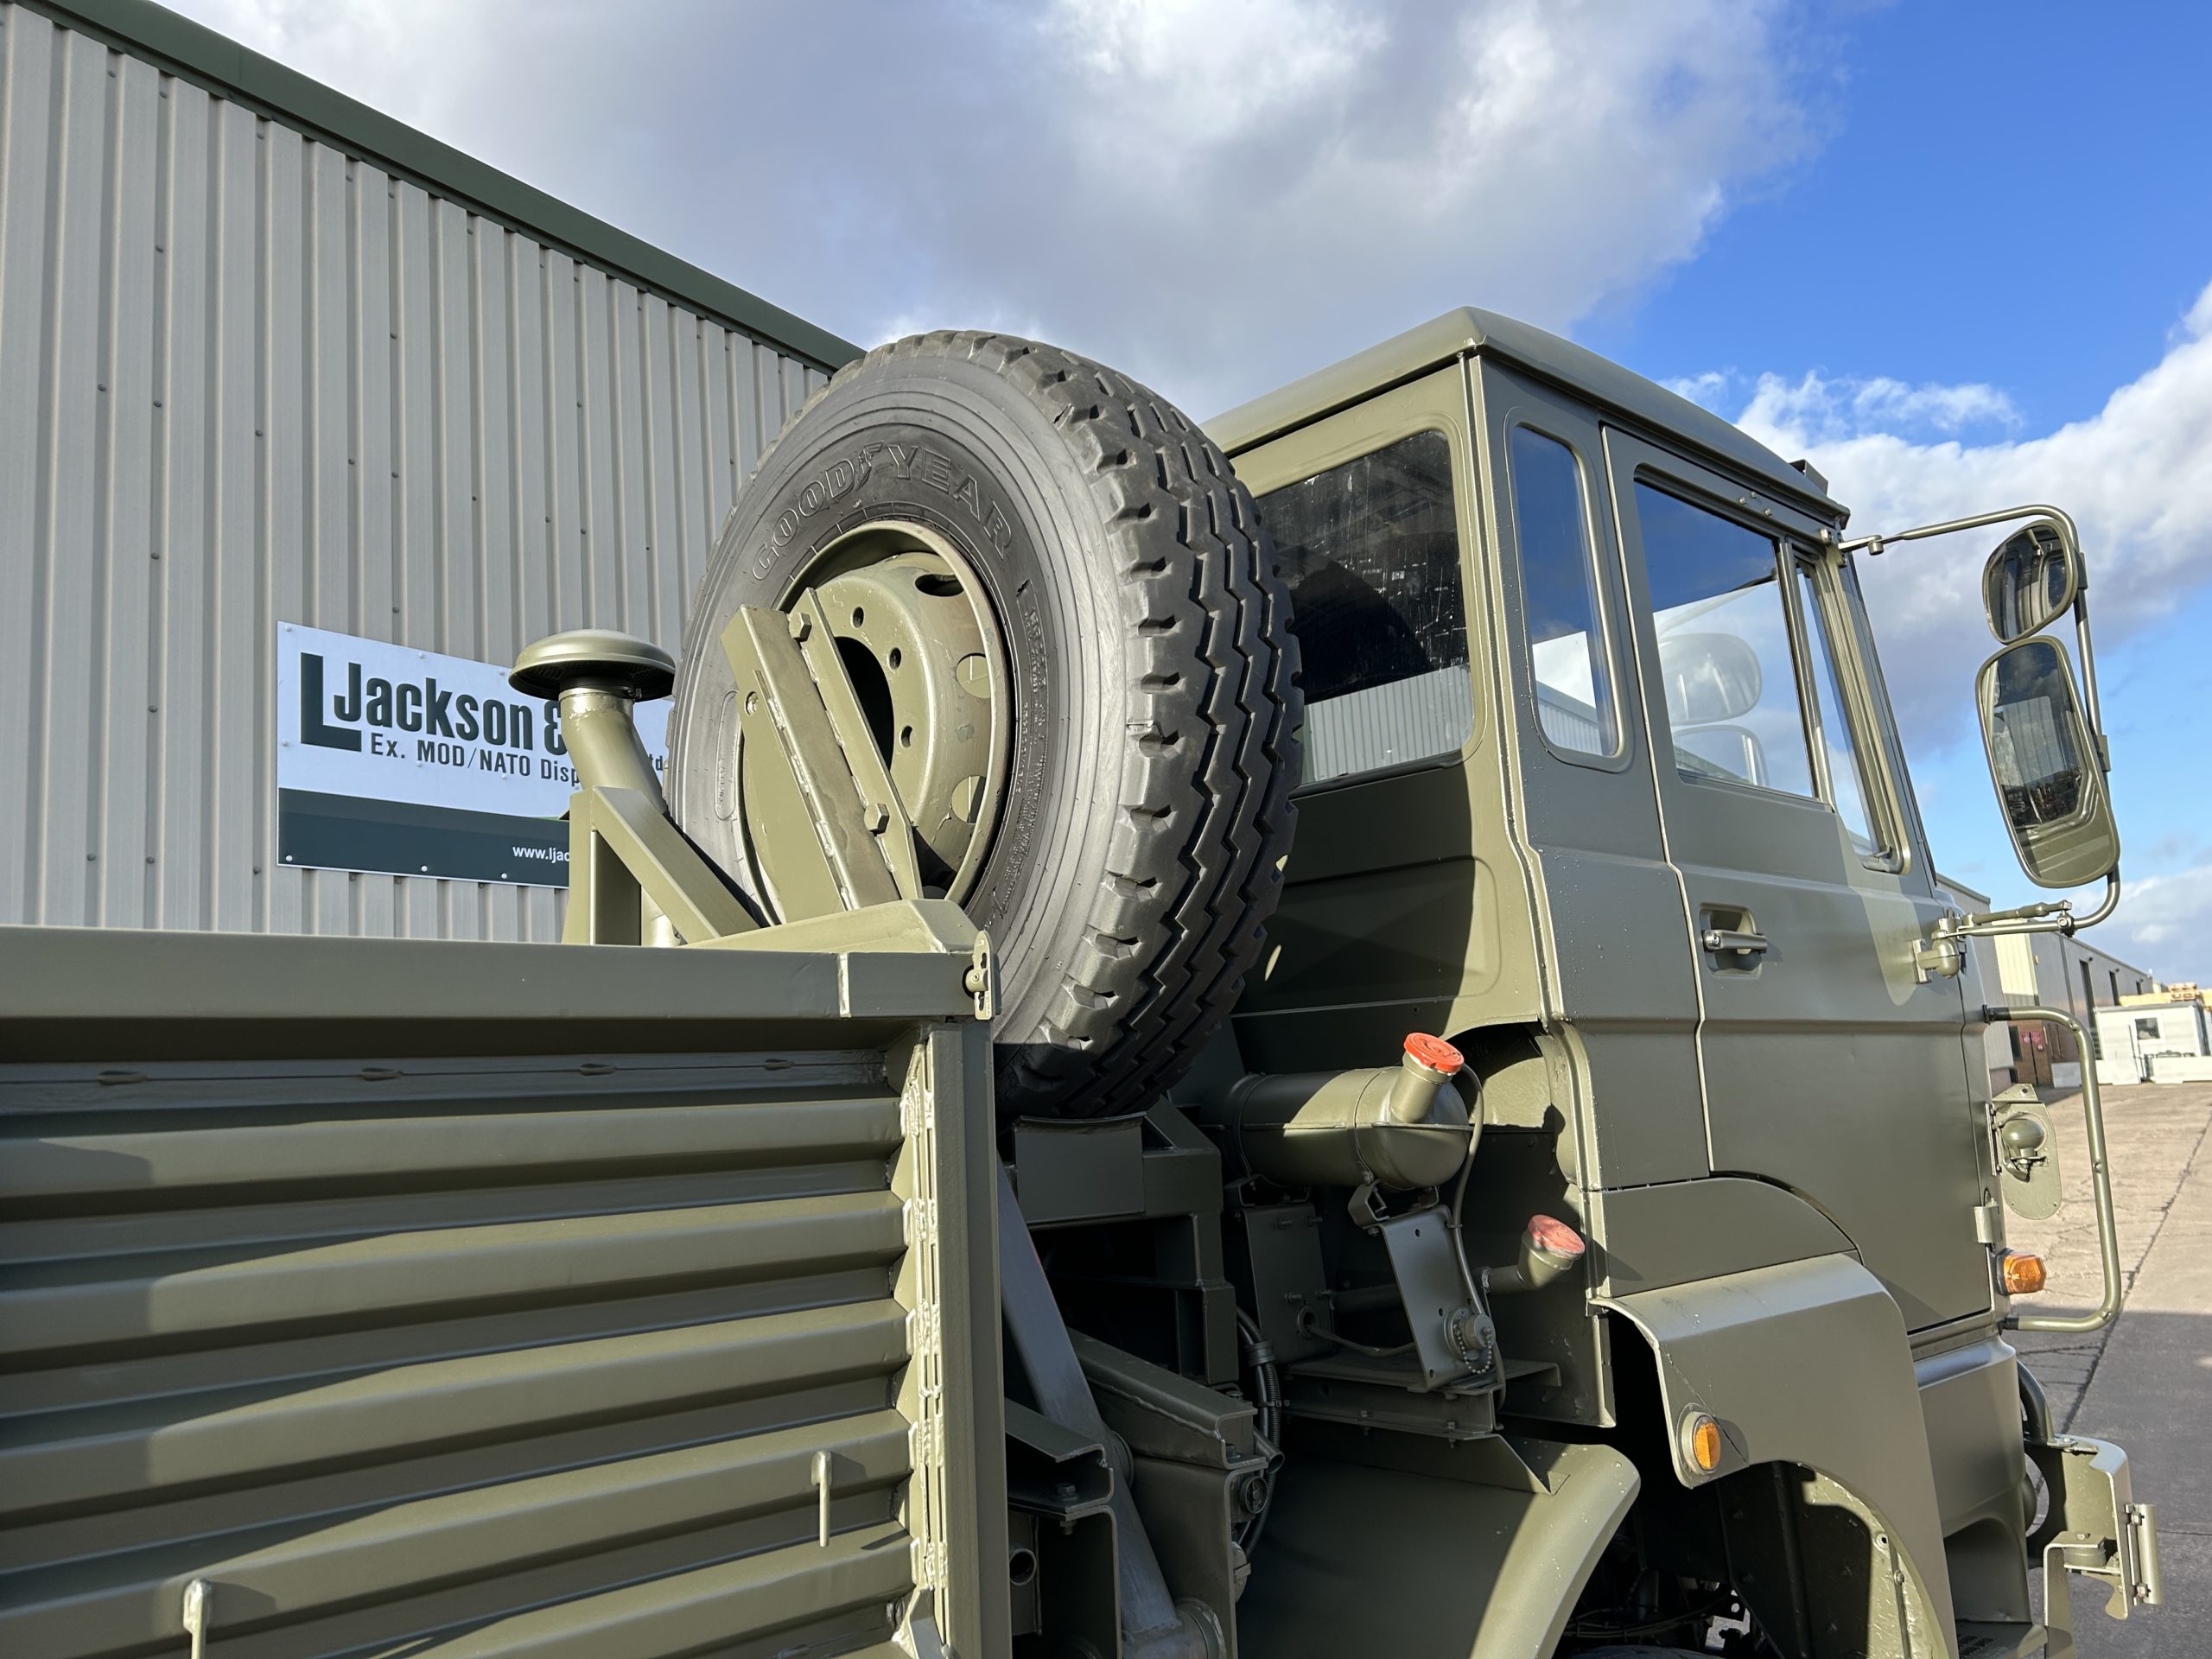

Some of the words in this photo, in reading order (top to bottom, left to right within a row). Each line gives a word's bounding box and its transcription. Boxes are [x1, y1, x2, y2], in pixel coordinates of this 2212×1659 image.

[751, 442, 1013, 581] GOODYEAR
[370, 733, 405, 759] Ex.
[417, 739, 531, 777] MOD/NATO
[541, 759, 580, 787] Disp
[512, 846, 569, 863] www.ljac
